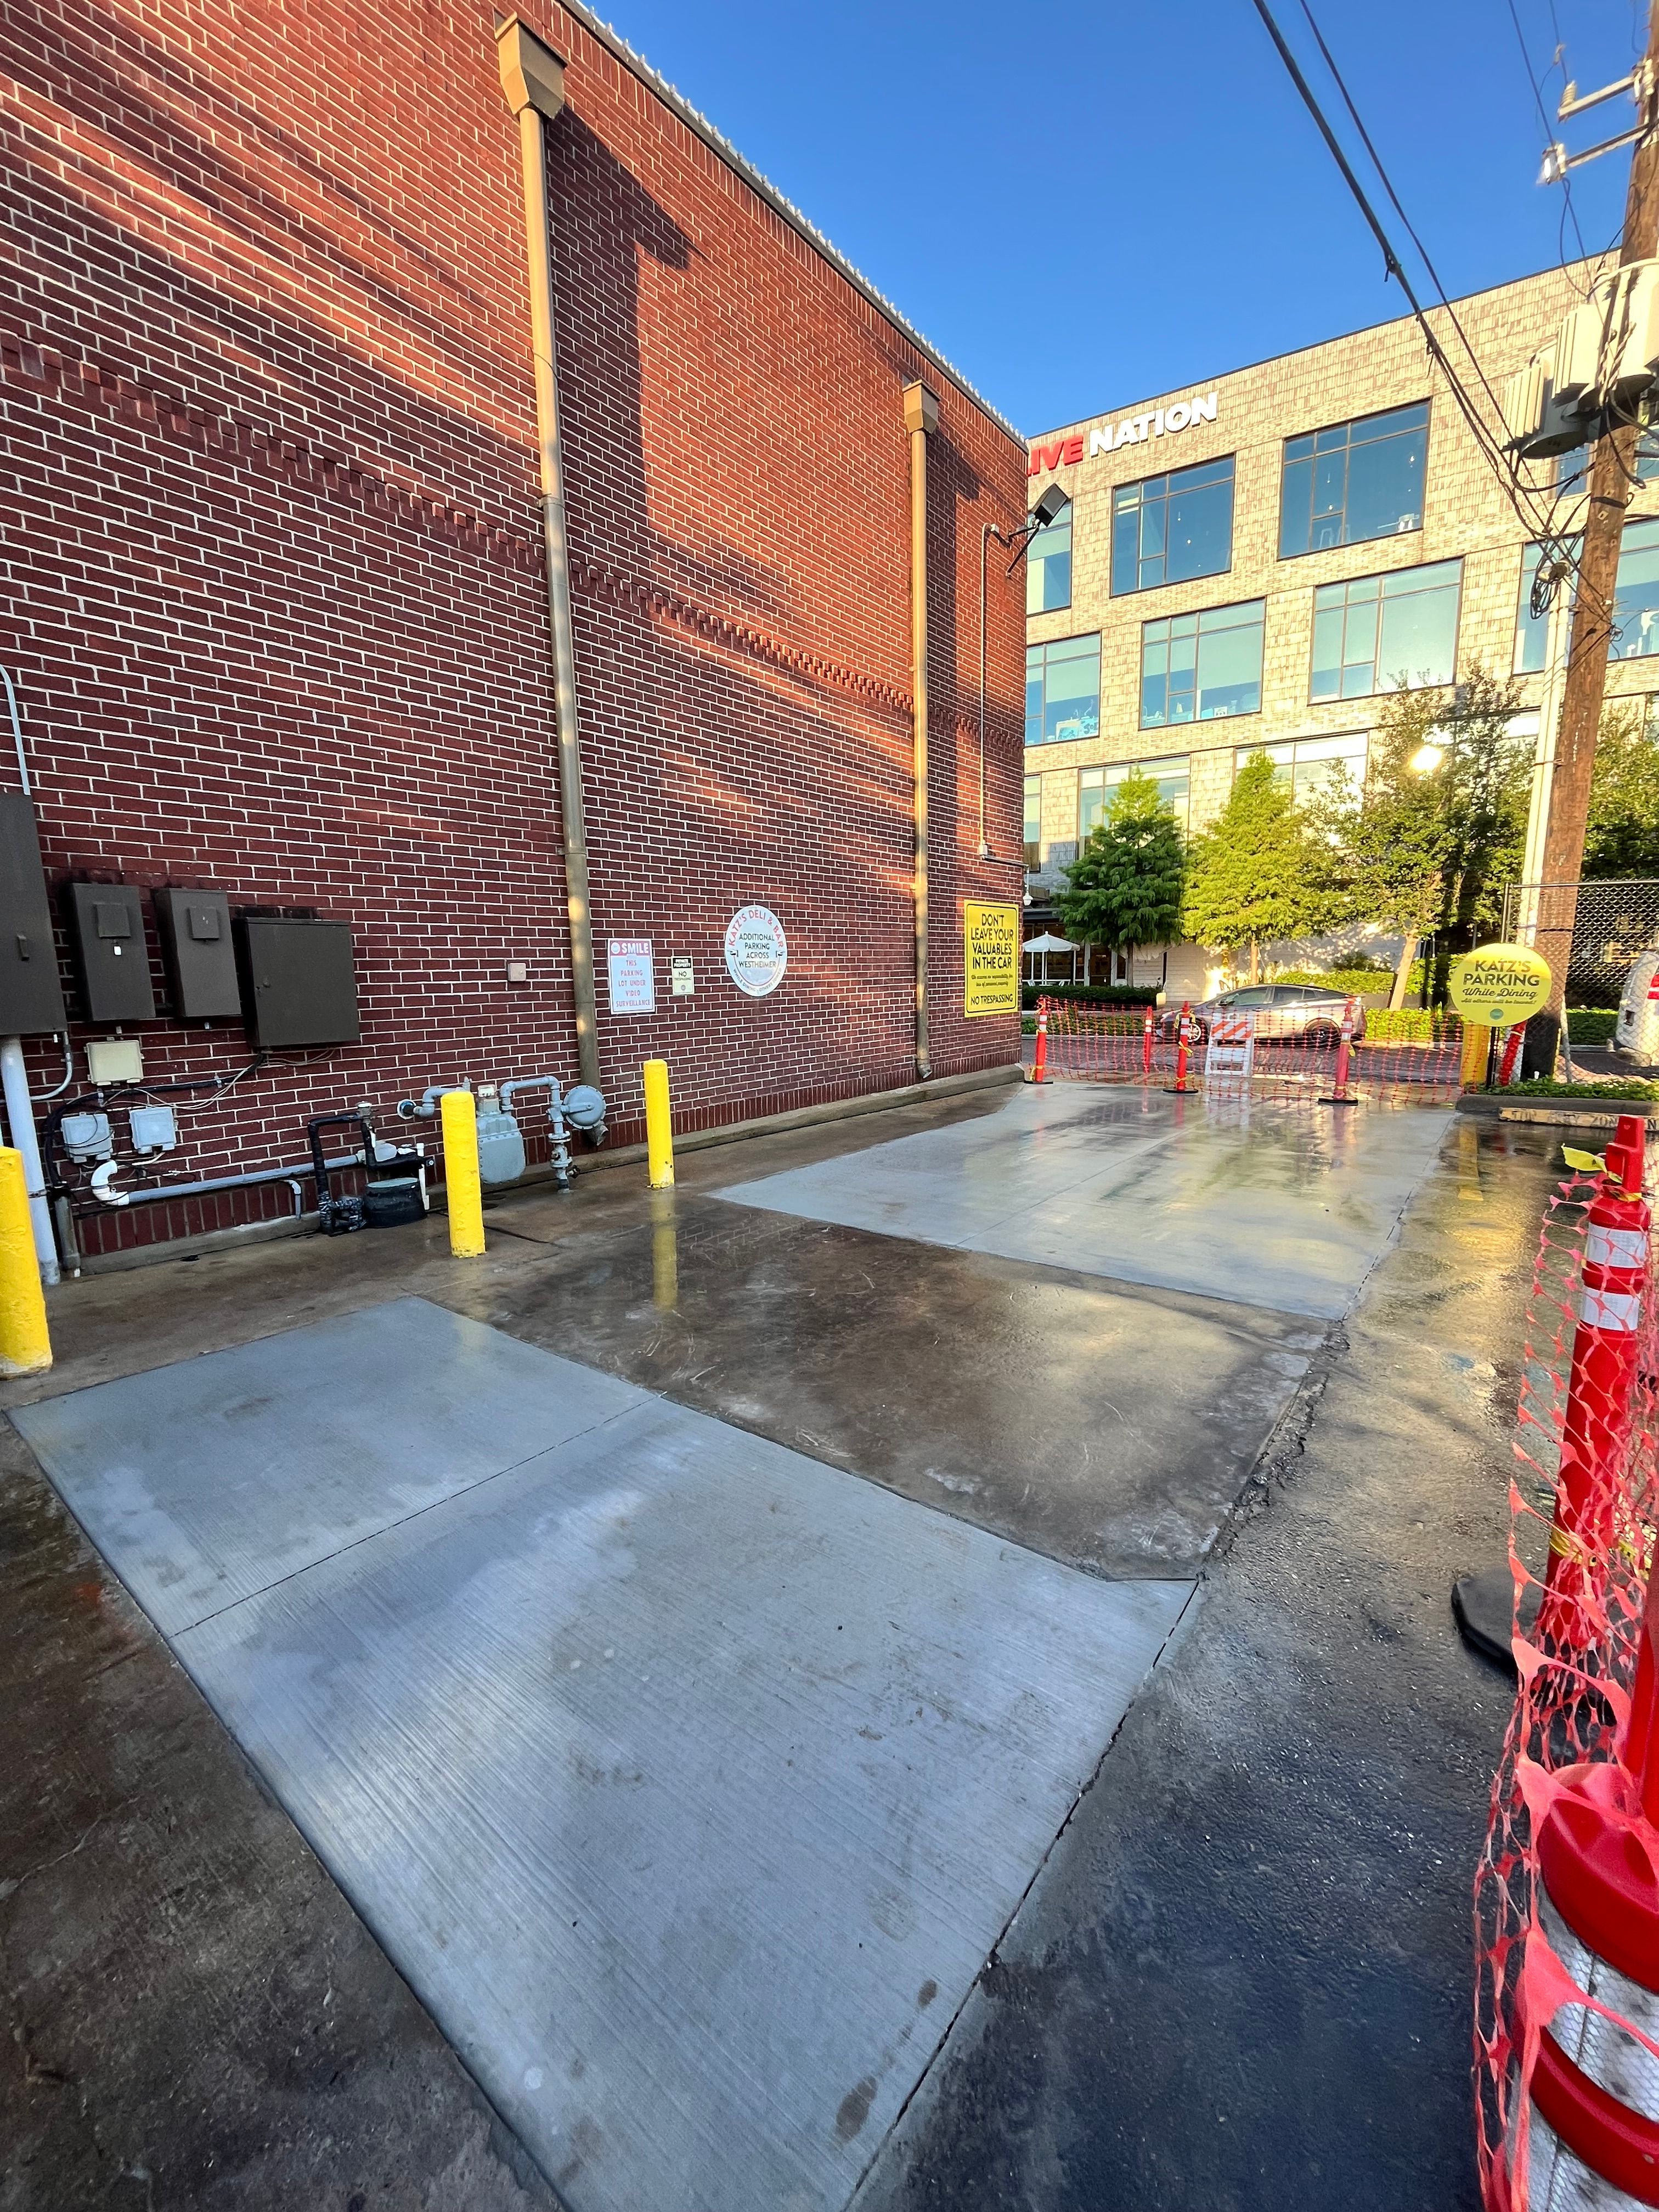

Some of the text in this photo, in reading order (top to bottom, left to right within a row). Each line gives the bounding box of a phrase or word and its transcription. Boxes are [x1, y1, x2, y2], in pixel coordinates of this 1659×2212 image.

[1028, 392, 1218, 477] IVE NATION
[728, 909, 784, 948] KATZ'S DELI & BAR
[971, 927, 1013, 941] LEAVE YOUR
[622, 943, 649, 954] SMILE
[972, 943, 1012, 955] VALUABLES
[973, 957, 1012, 969] IN THE CAR
[1475, 960, 1531, 973] KATZ'S
[1463, 973, 1541, 986] PARKING
[971, 994, 1013, 1005] NO TRESPASSING
[1462, 988, 1538, 1000] While Dining
